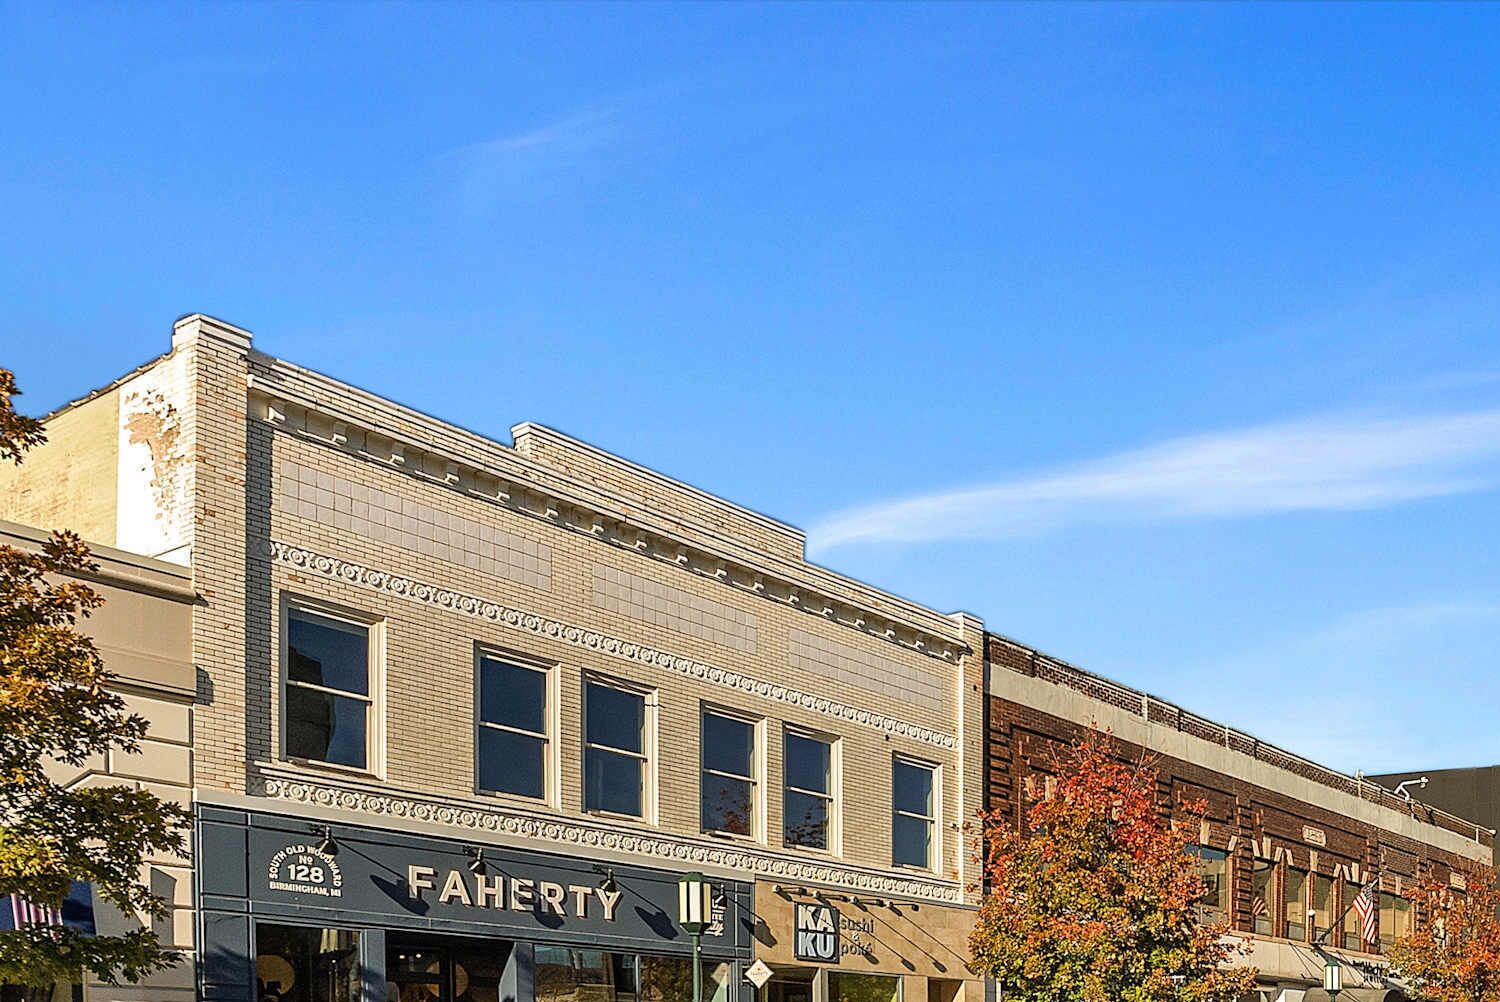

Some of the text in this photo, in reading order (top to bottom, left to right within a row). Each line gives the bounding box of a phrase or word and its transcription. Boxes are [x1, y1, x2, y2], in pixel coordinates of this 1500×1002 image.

[268, 844, 342, 887] SOUTH OLD WOODWARD
[287, 864, 325, 883] 128
[269, 881, 330, 897] BIRMINGHAM,
[408, 864, 622, 921] FAHERTY
[798, 904, 836, 932] KA
[840, 917, 874, 933] sushi
[798, 931, 836, 958] KU
